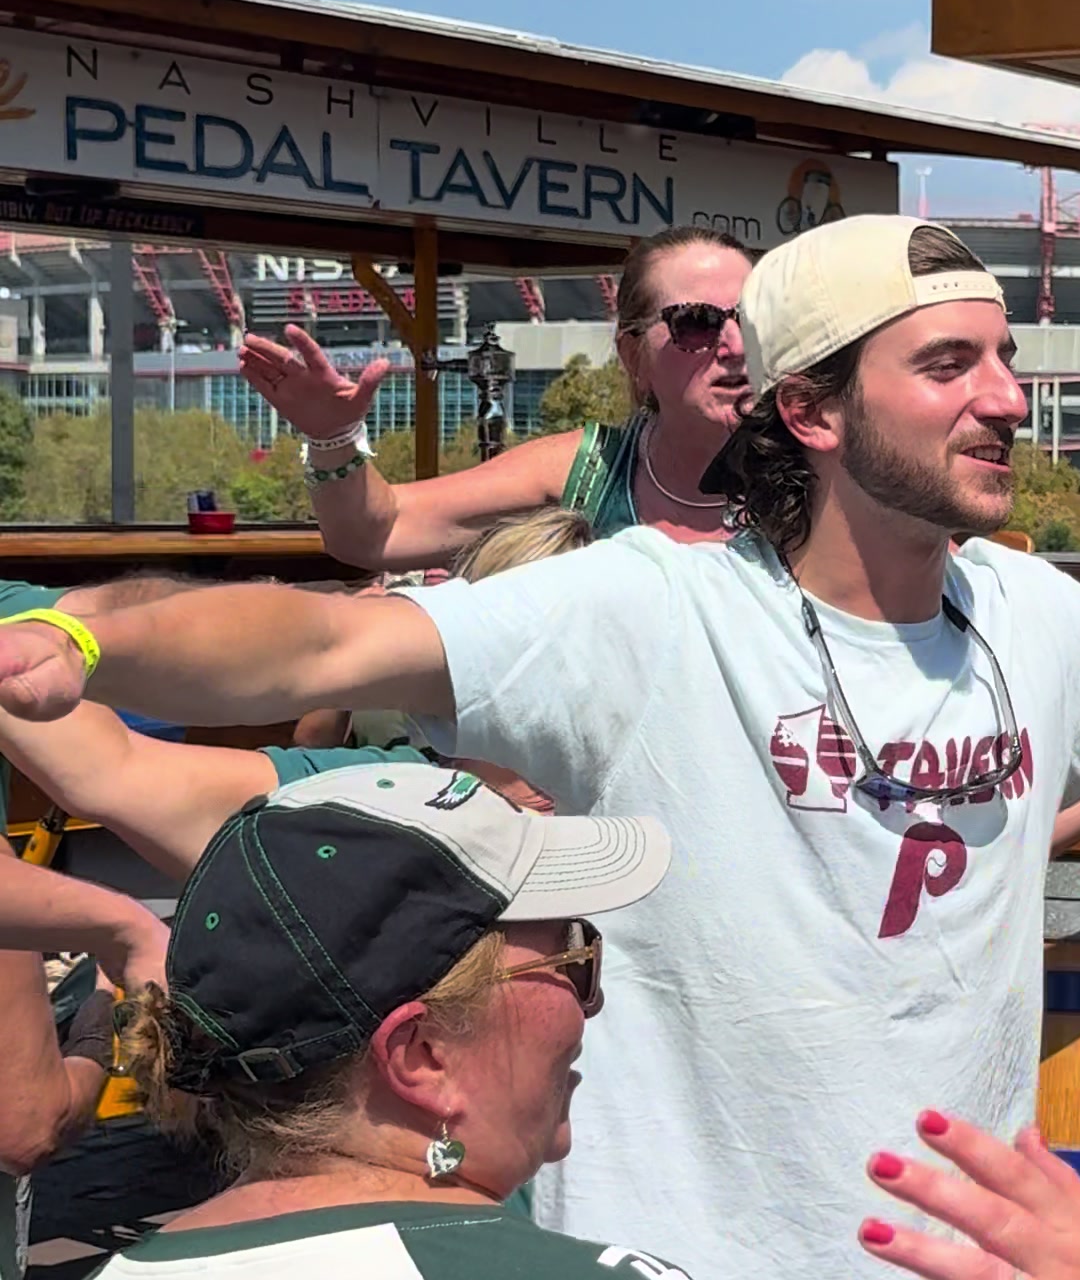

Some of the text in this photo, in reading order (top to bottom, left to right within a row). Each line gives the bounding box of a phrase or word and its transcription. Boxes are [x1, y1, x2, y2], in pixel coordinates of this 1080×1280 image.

[65, 95, 370, 194] PEDAL
[389, 139, 674, 225] TAVERN
[66, 45, 677, 162] NASHVILLE
[878, 821, 967, 938] P
